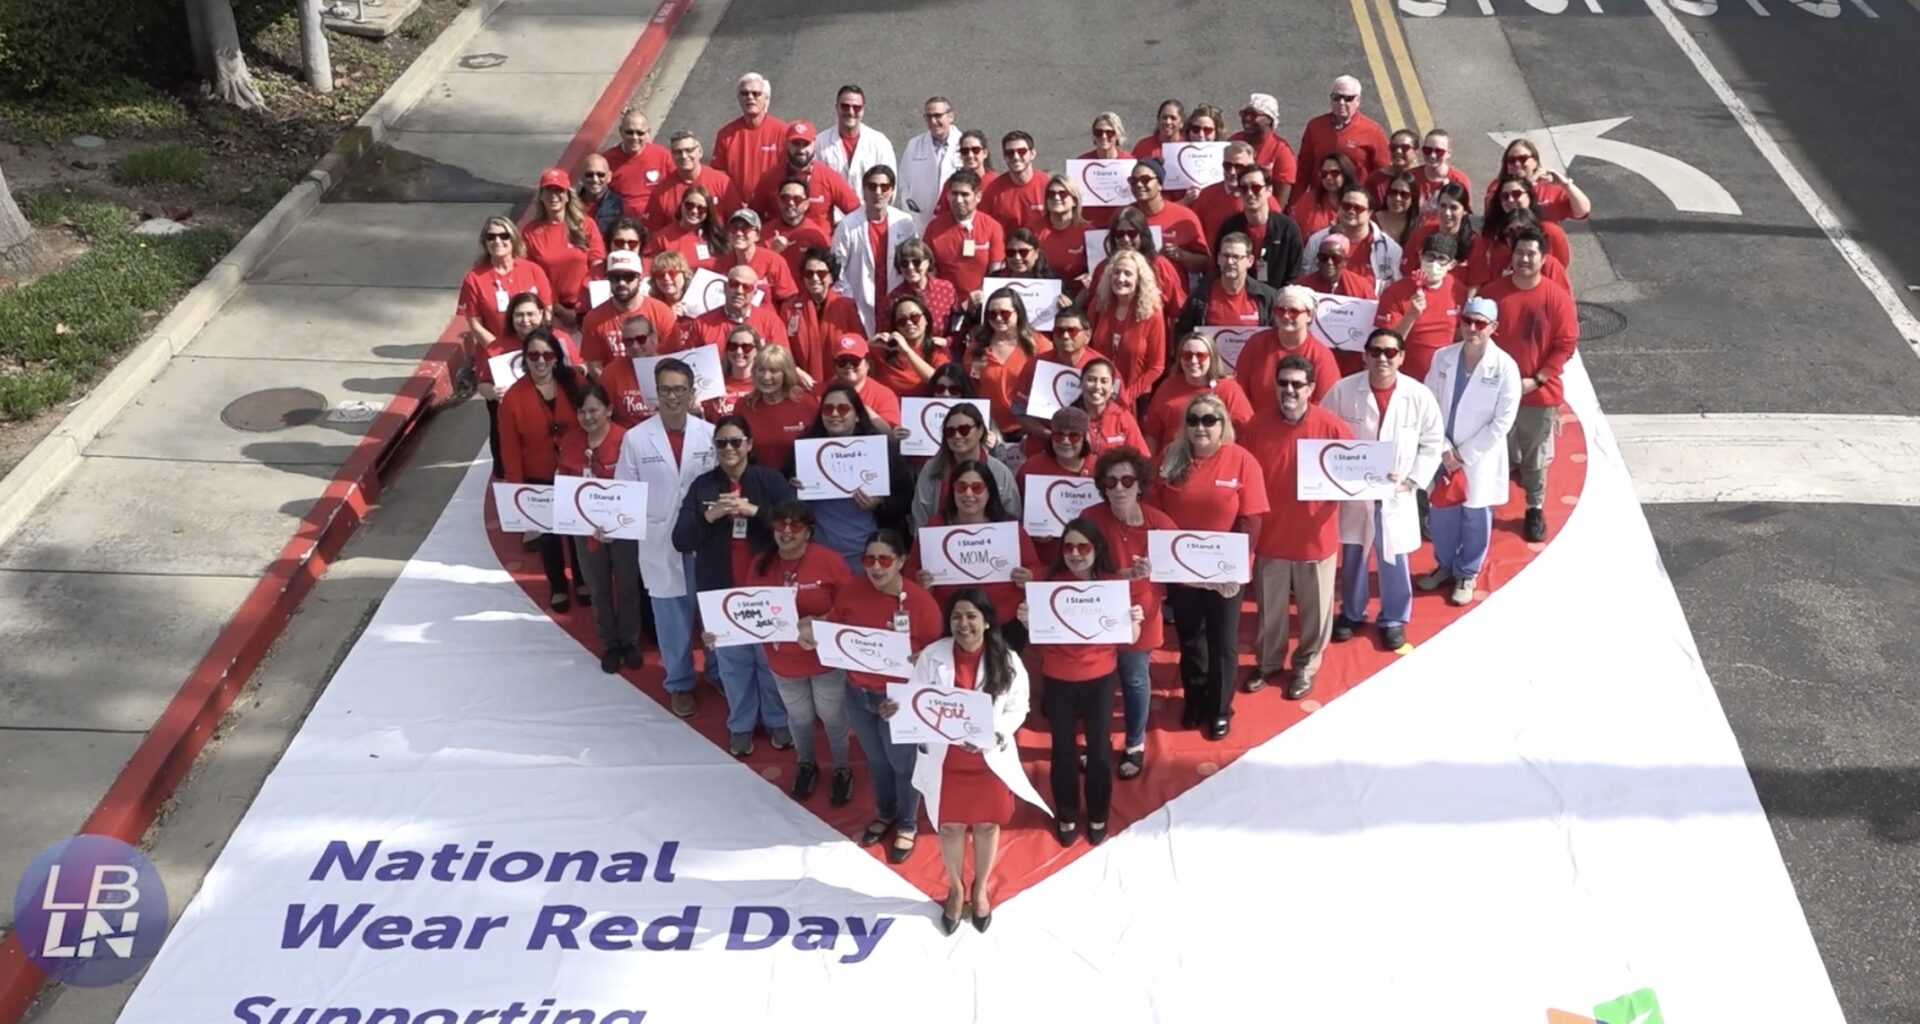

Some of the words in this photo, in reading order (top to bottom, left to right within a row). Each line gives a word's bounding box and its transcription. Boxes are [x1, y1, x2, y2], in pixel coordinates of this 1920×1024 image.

[960, 549, 989, 565] MOM
[734, 608, 763, 620] MOM
[854, 638, 876, 647] Stand
[934, 700, 958, 708] Stand
[308, 839, 680, 884] National
[281, 903, 509, 950] Wear
[526, 904, 702, 951] Red
[724, 905, 896, 964] Day
